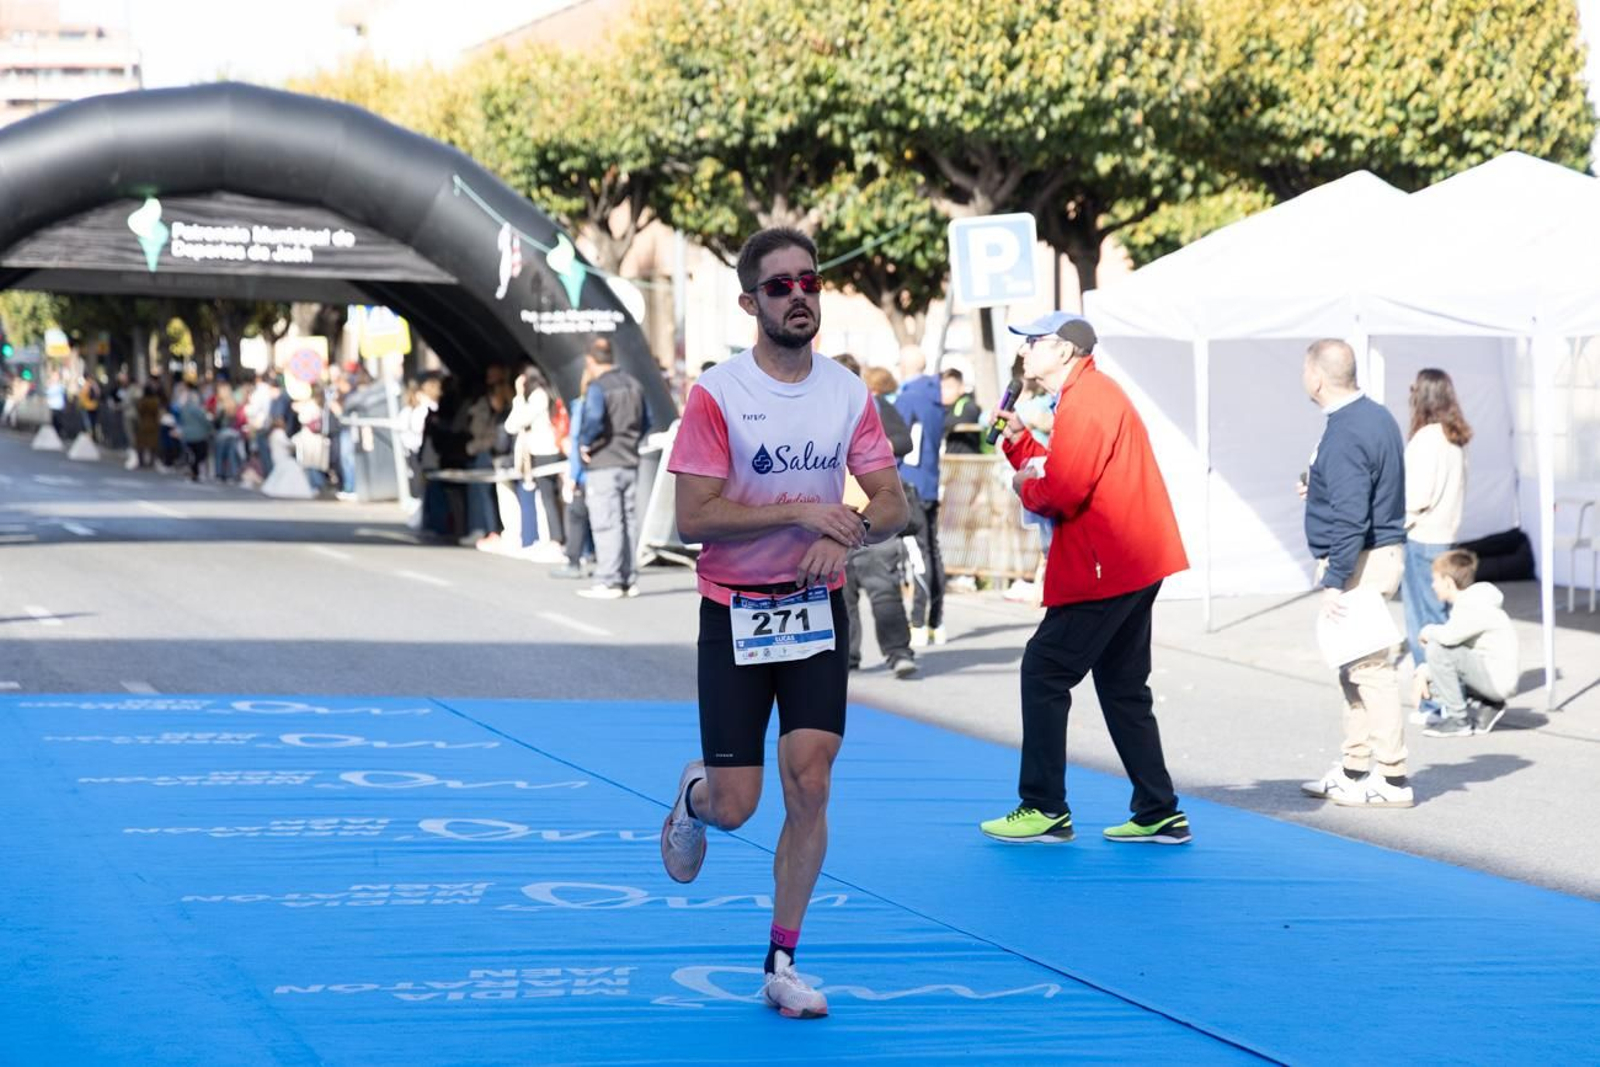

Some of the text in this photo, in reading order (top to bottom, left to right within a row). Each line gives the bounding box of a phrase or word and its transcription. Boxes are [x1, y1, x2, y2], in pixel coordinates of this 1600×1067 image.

[967, 227, 1020, 296] P
[772, 441, 841, 474] Salud
[752, 608, 810, 636] 271
[393, 988, 629, 1001] MEDIA
